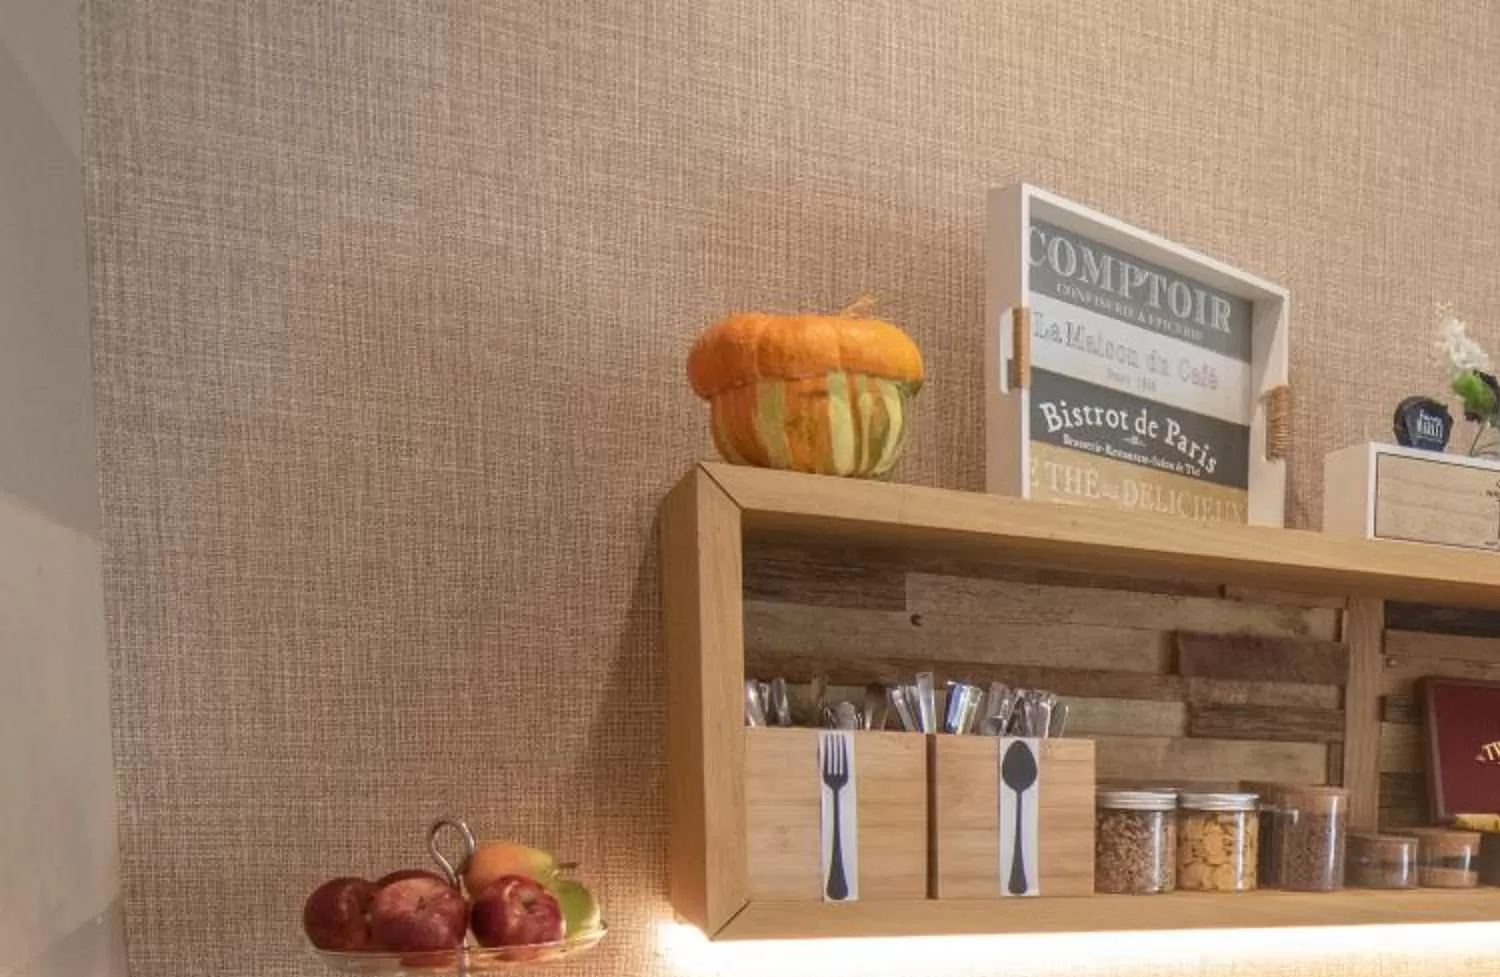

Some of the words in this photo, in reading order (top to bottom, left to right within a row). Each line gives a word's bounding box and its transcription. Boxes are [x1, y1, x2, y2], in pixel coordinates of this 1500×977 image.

[1029, 225, 1231, 334] COMPTOIR
[1040, 400, 1129, 432] Bistrot
[1135, 408, 1159, 437] de
[1164, 418, 1217, 473] Paris
